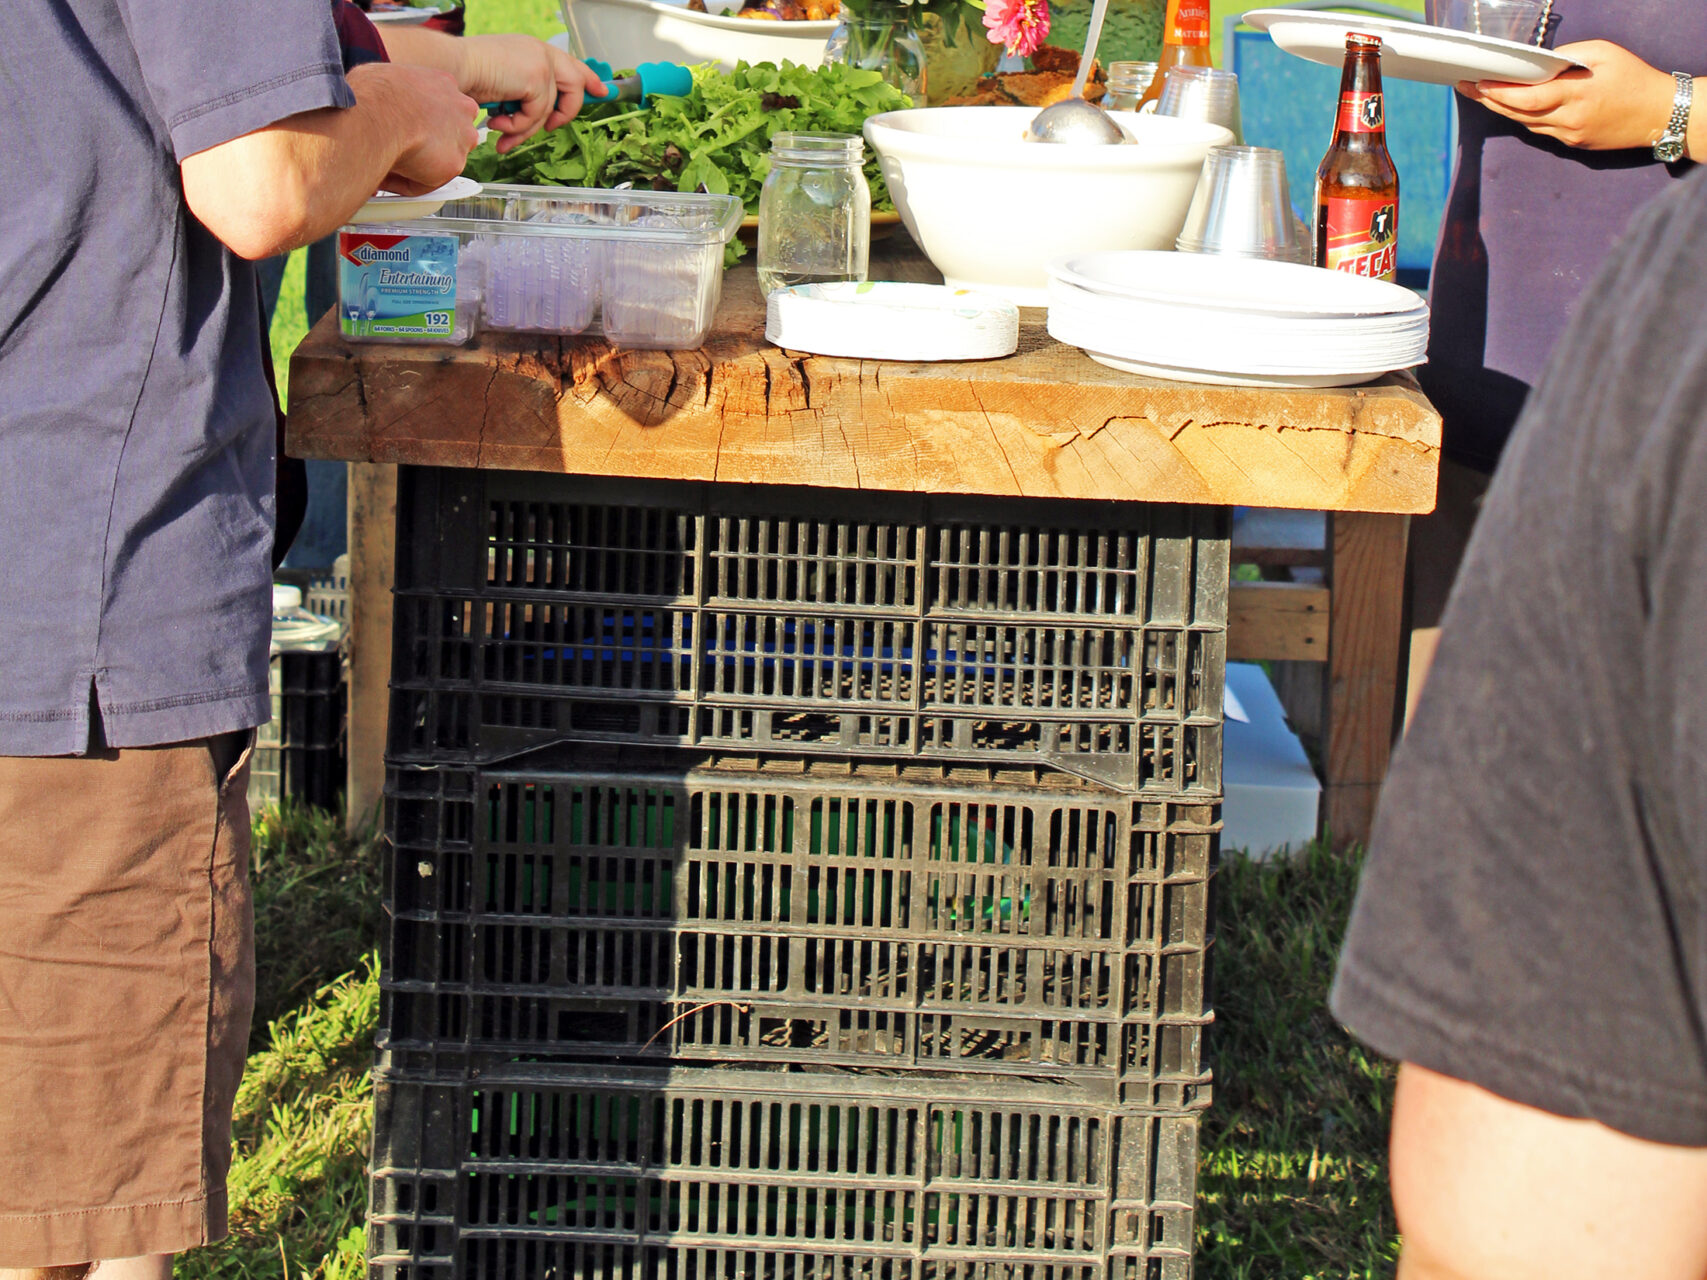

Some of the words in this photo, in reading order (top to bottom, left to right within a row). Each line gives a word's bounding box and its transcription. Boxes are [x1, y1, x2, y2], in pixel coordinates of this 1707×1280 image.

[1367, 102, 1378, 118] T
[1376, 213, 1387, 233] T
[360, 247, 410, 262] diamond
[379, 269, 453, 293] Entertaining
[425, 313, 449, 325] 192
